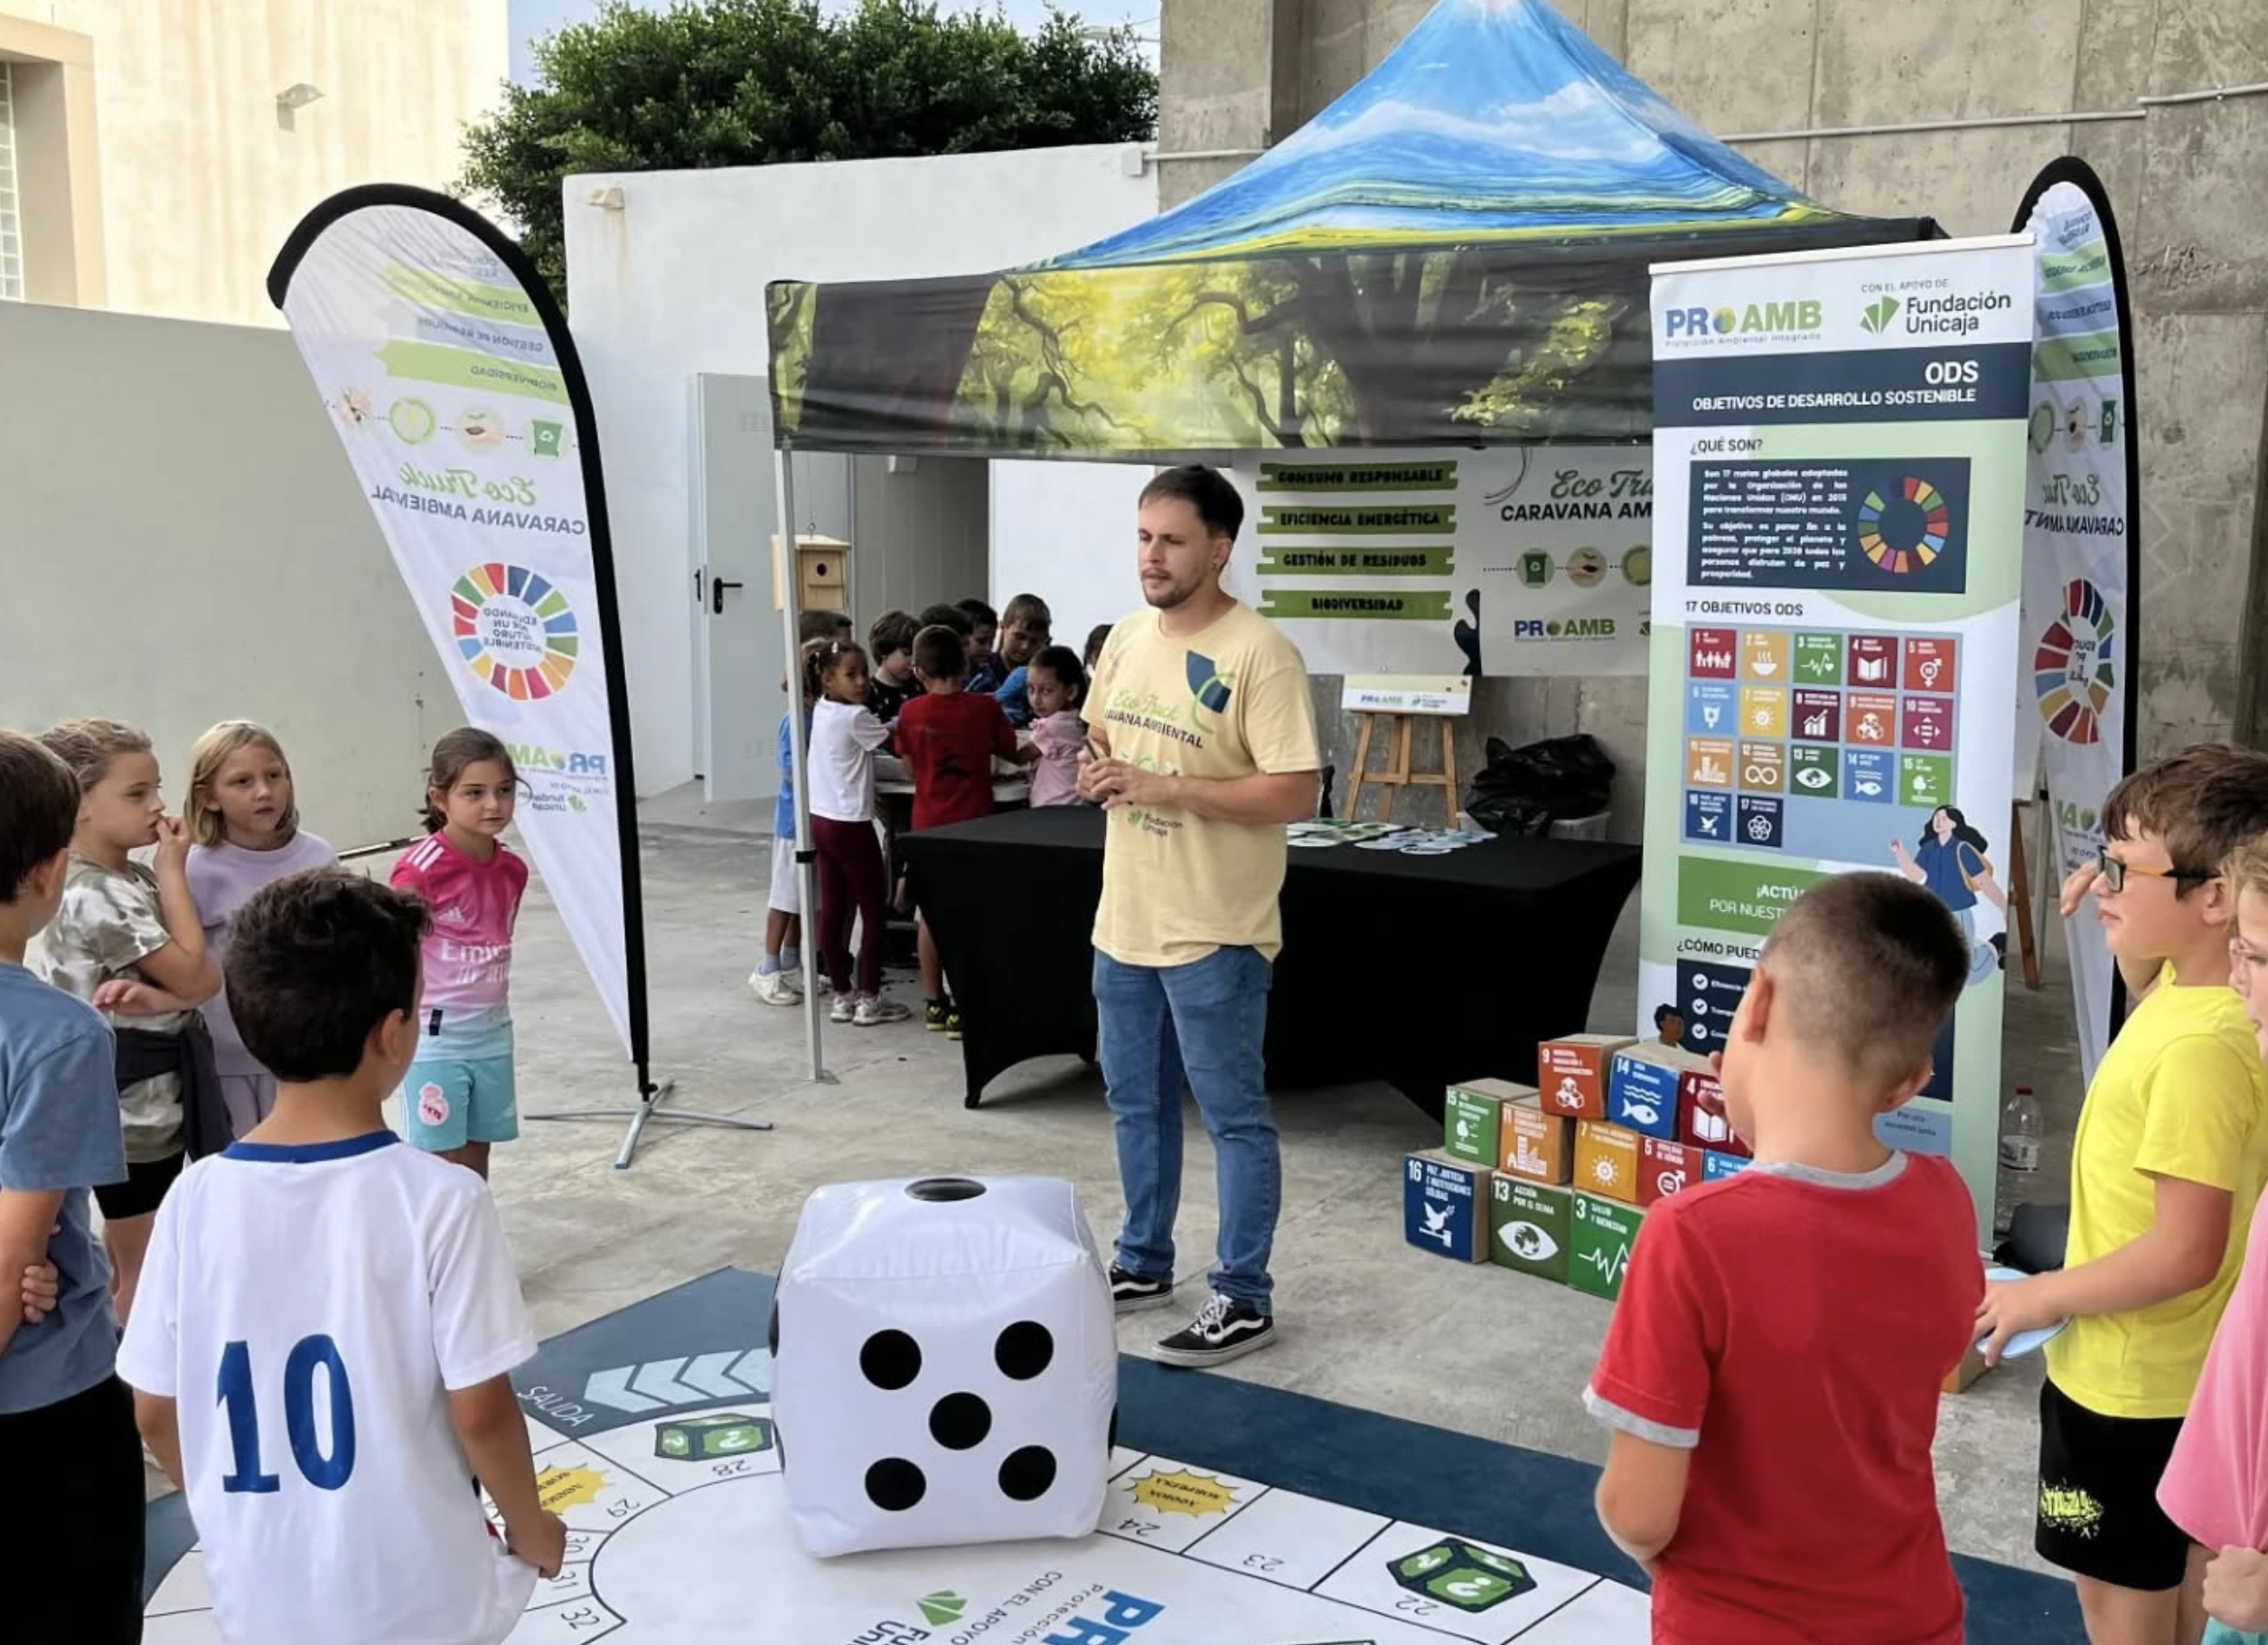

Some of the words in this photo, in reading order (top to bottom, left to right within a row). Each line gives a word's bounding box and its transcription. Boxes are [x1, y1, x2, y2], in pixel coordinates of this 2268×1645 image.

[1861, 284, 1882, 294] CON
[1885, 283, 1895, 292] EL
[1899, 280, 1933, 290] APOYO
[1907, 290, 2011, 315] Fundación
[1666, 299, 1822, 338] PROAMB
[1907, 313, 1979, 336] Unicaja
[1925, 360, 1979, 384] ODS
[1692, 395, 1764, 410] OBJETIVOS
[1767, 394, 1786, 409] DE
[1787, 391, 1882, 408] DESARROLLO
[1884, 389, 1976, 405] SOSTENIBLE
[1690, 436, 1725, 456] ¿QUÉ
[1728, 438, 1763, 452] SON?
[1279, 471, 1345, 484] CONSUMO
[1349, 468, 1443, 484] RESPONSABLE
[1551, 469, 1604, 499] Eco
[1280, 512, 1352, 526] EFICIENCIA
[1357, 509, 1440, 526] ENERGÉTICA
[1500, 502, 1613, 522] CARAVANA
[1283, 550, 1335, 567] GESTIÓN
[1341, 554, 1357, 567] DE
[1363, 553, 1427, 567] RESIDUOS
[1312, 597, 1403, 612] BIODIVERSIDAD
[1686, 601, 1698, 613] 17
[1701, 601, 1771, 615] OBJETIVOS
[1775, 603, 1804, 616] ODS
[1514, 618, 1616, 636] PROAMB
[1852, 639, 1860, 651] 4
[1757, 884, 1804, 900] ¡ACTÚ
[1710, 898, 1737, 915] POR
[1740, 903, 1785, 919] NUEST
[1676, 938, 1724, 954] ¿CÓMO
[1542, 1048, 1550, 1064] 9
[1617, 1058, 1629, 1076] 14
[1686, 1077, 1695, 1095] 4
[1448, 1090, 1457, 1106] 15
[1581, 1121, 1589, 1136] 7
[1645, 1139, 1652, 1155] 5
[1408, 1160, 1422, 1182] 16
[1708, 1156, 1715, 1173] 6
[1493, 1180, 1509, 1202] 13
[1576, 1198, 1587, 1219] 3
[216, 1333, 356, 1493] 10
[516, 1386, 597, 1427] SALIDA
[711, 1459, 751, 1477] 28
[606, 1498, 641, 1518] 29
[1118, 1518, 1160, 1537] 24
[565, 1534, 590, 1555] 30
[1242, 1554, 1285, 1572] 23
[548, 1571, 579, 1591] 31
[1025, 1571, 1063, 1596] CON
[1002, 1593, 1031, 1606] EL
[1395, 1595, 1439, 1616] 22
[559, 1606, 601, 1631] 32
[1012, 1584, 1104, 1645] Protección
[951, 1608, 1008, 1645] APOYO
